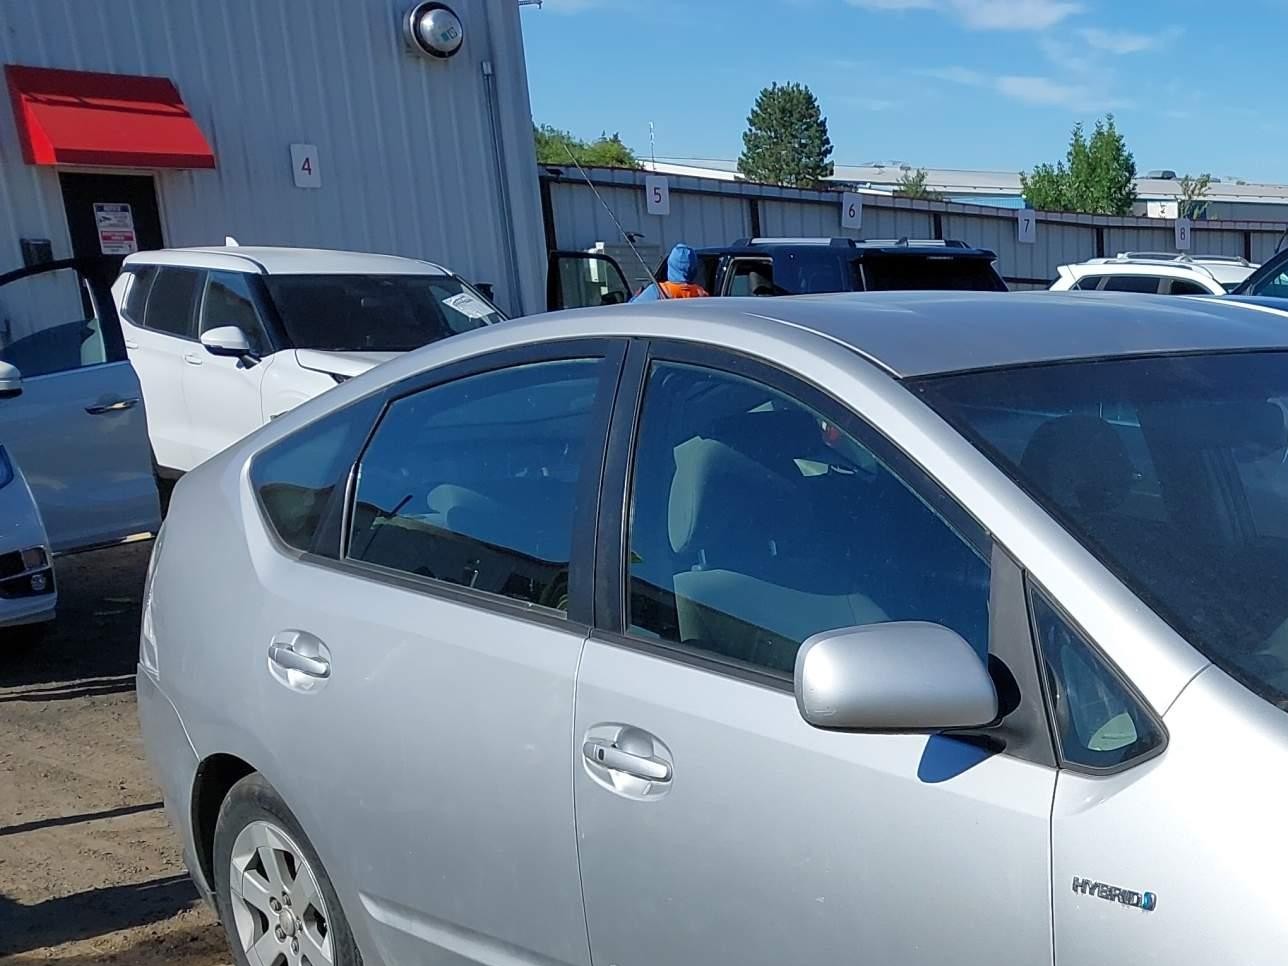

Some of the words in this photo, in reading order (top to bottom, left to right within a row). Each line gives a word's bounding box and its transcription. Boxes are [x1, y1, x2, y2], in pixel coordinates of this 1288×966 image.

[301, 157, 312, 176] 4
[653, 187, 662, 203] 5
[848, 203, 856, 218] 6
[1023, 218, 1030, 233] 7
[1179, 227, 1186, 241] 8
[1072, 876, 1143, 908] HYBRID
